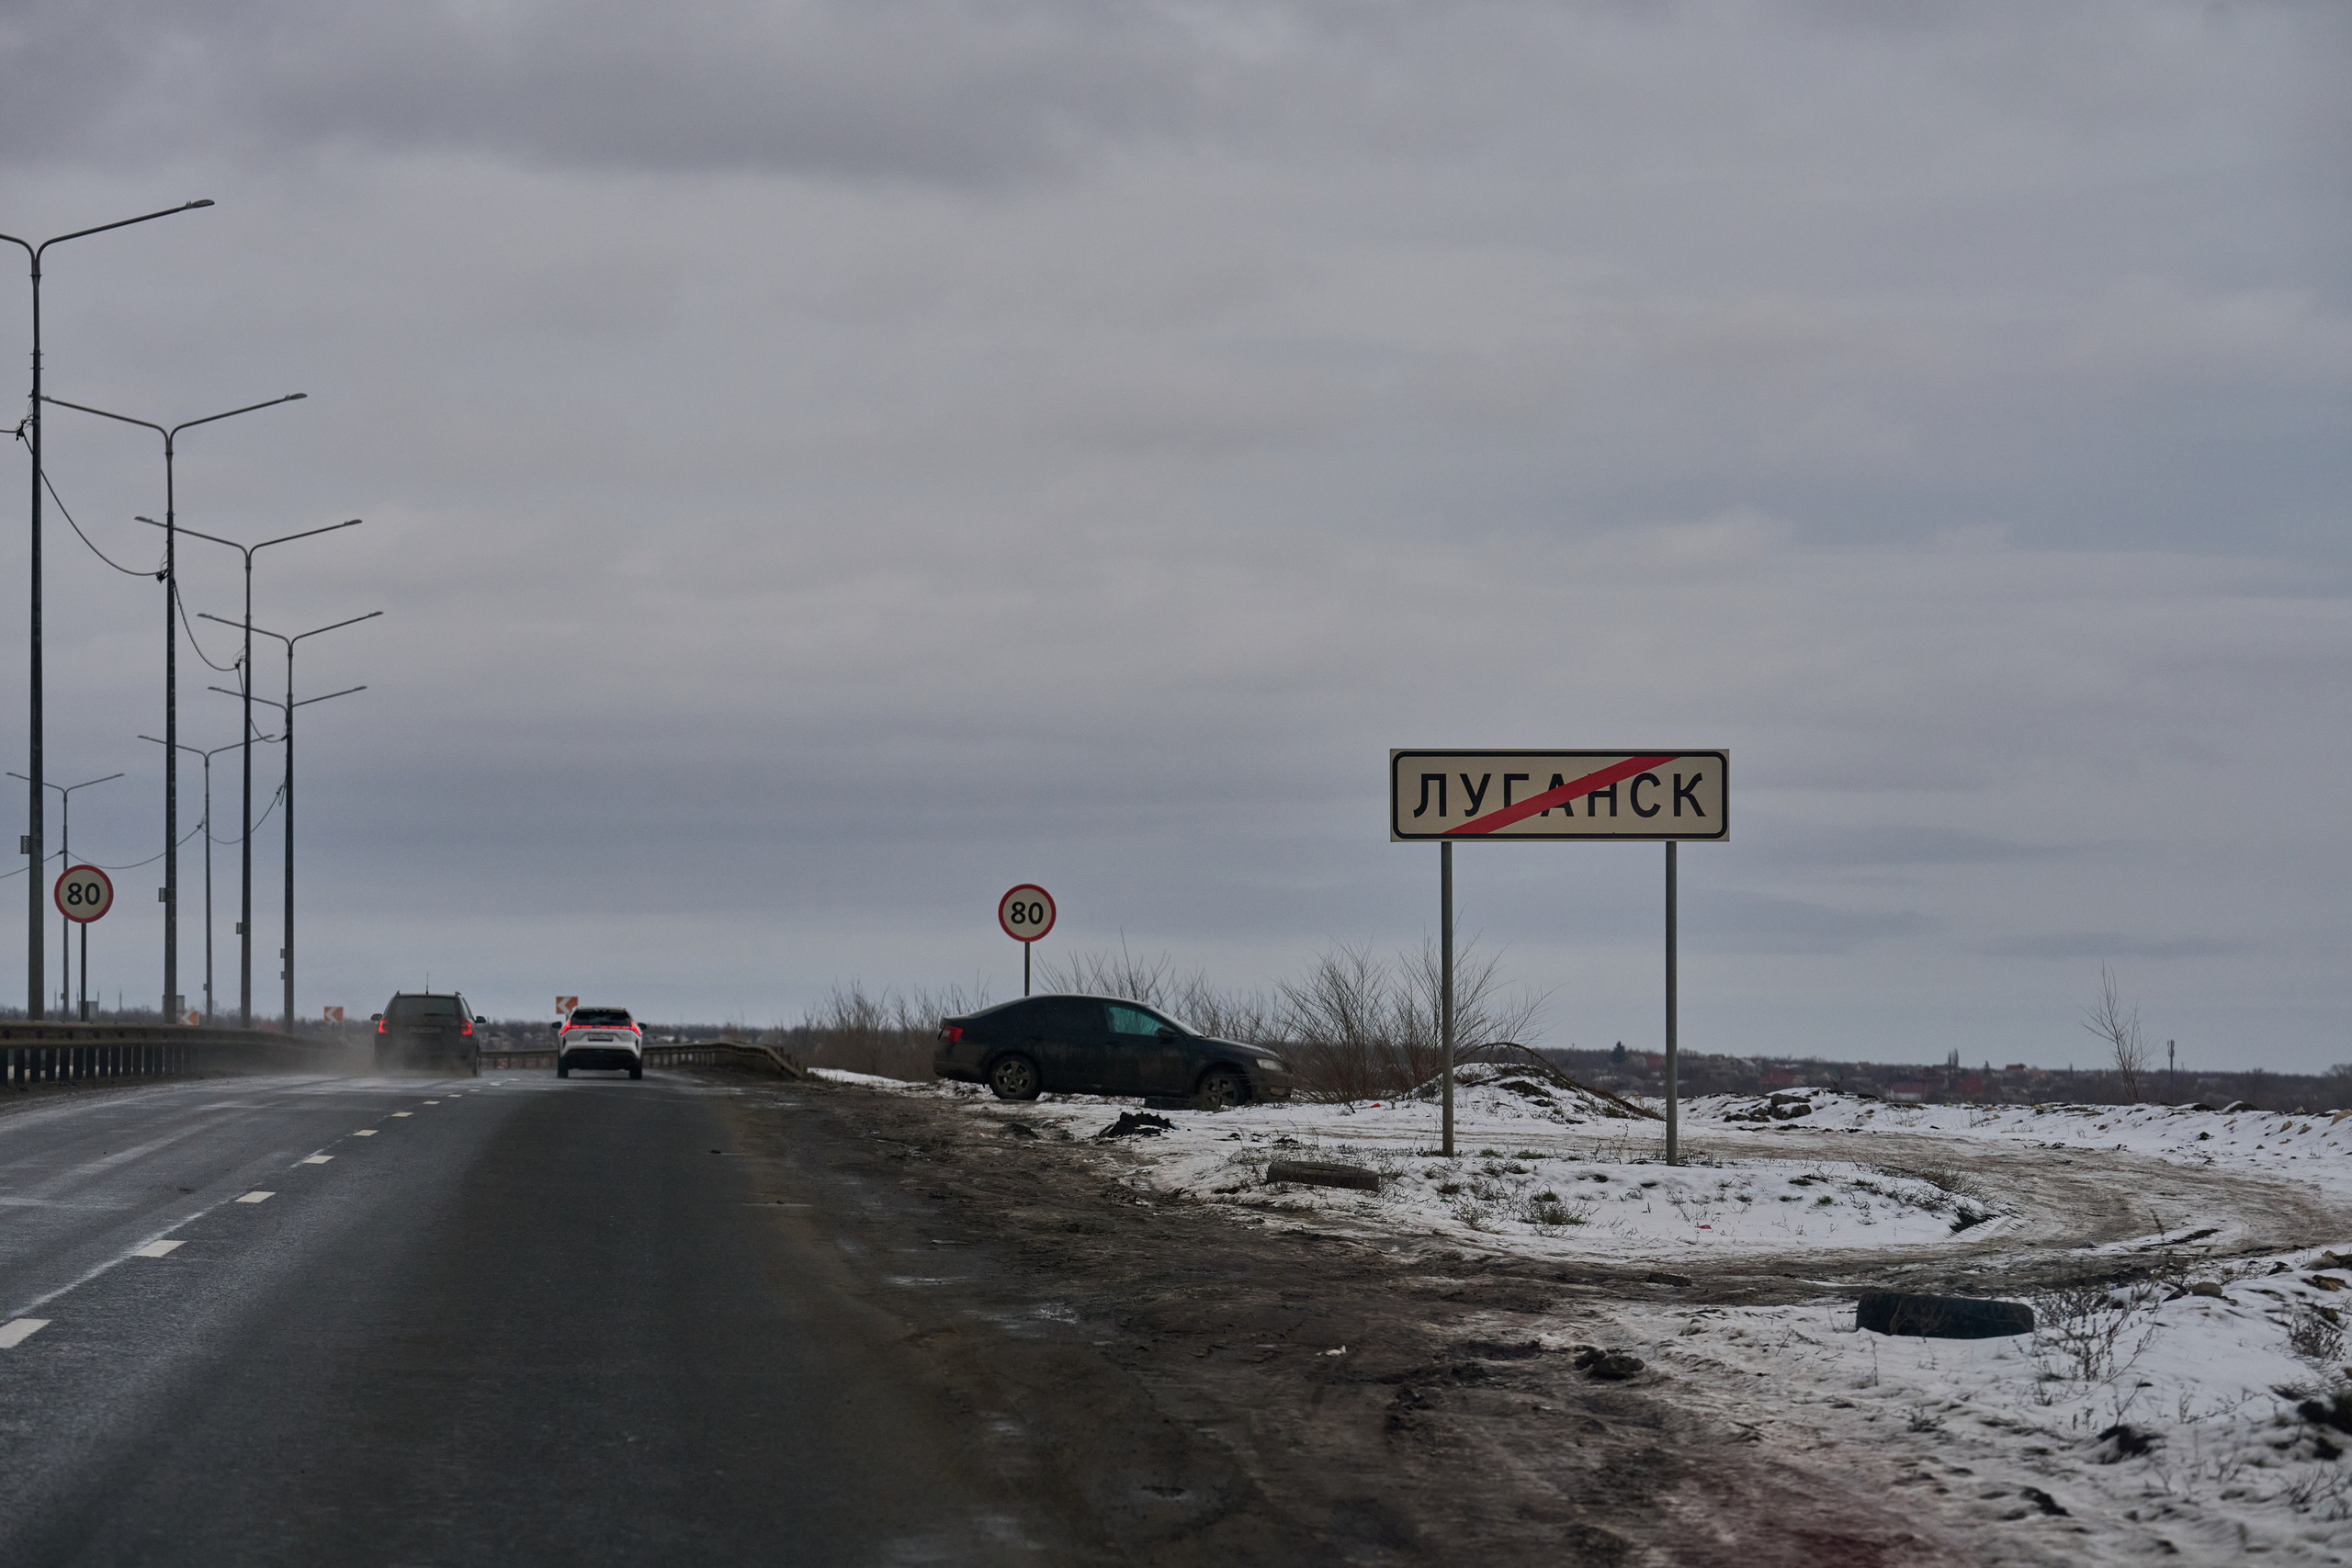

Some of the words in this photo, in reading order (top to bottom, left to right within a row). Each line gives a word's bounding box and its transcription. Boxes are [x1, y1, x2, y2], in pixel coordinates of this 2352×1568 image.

[1413, 773, 1706, 818] ЛУГАНСК
[67, 882, 100, 906] 80
[1011, 901, 1044, 925] 80
